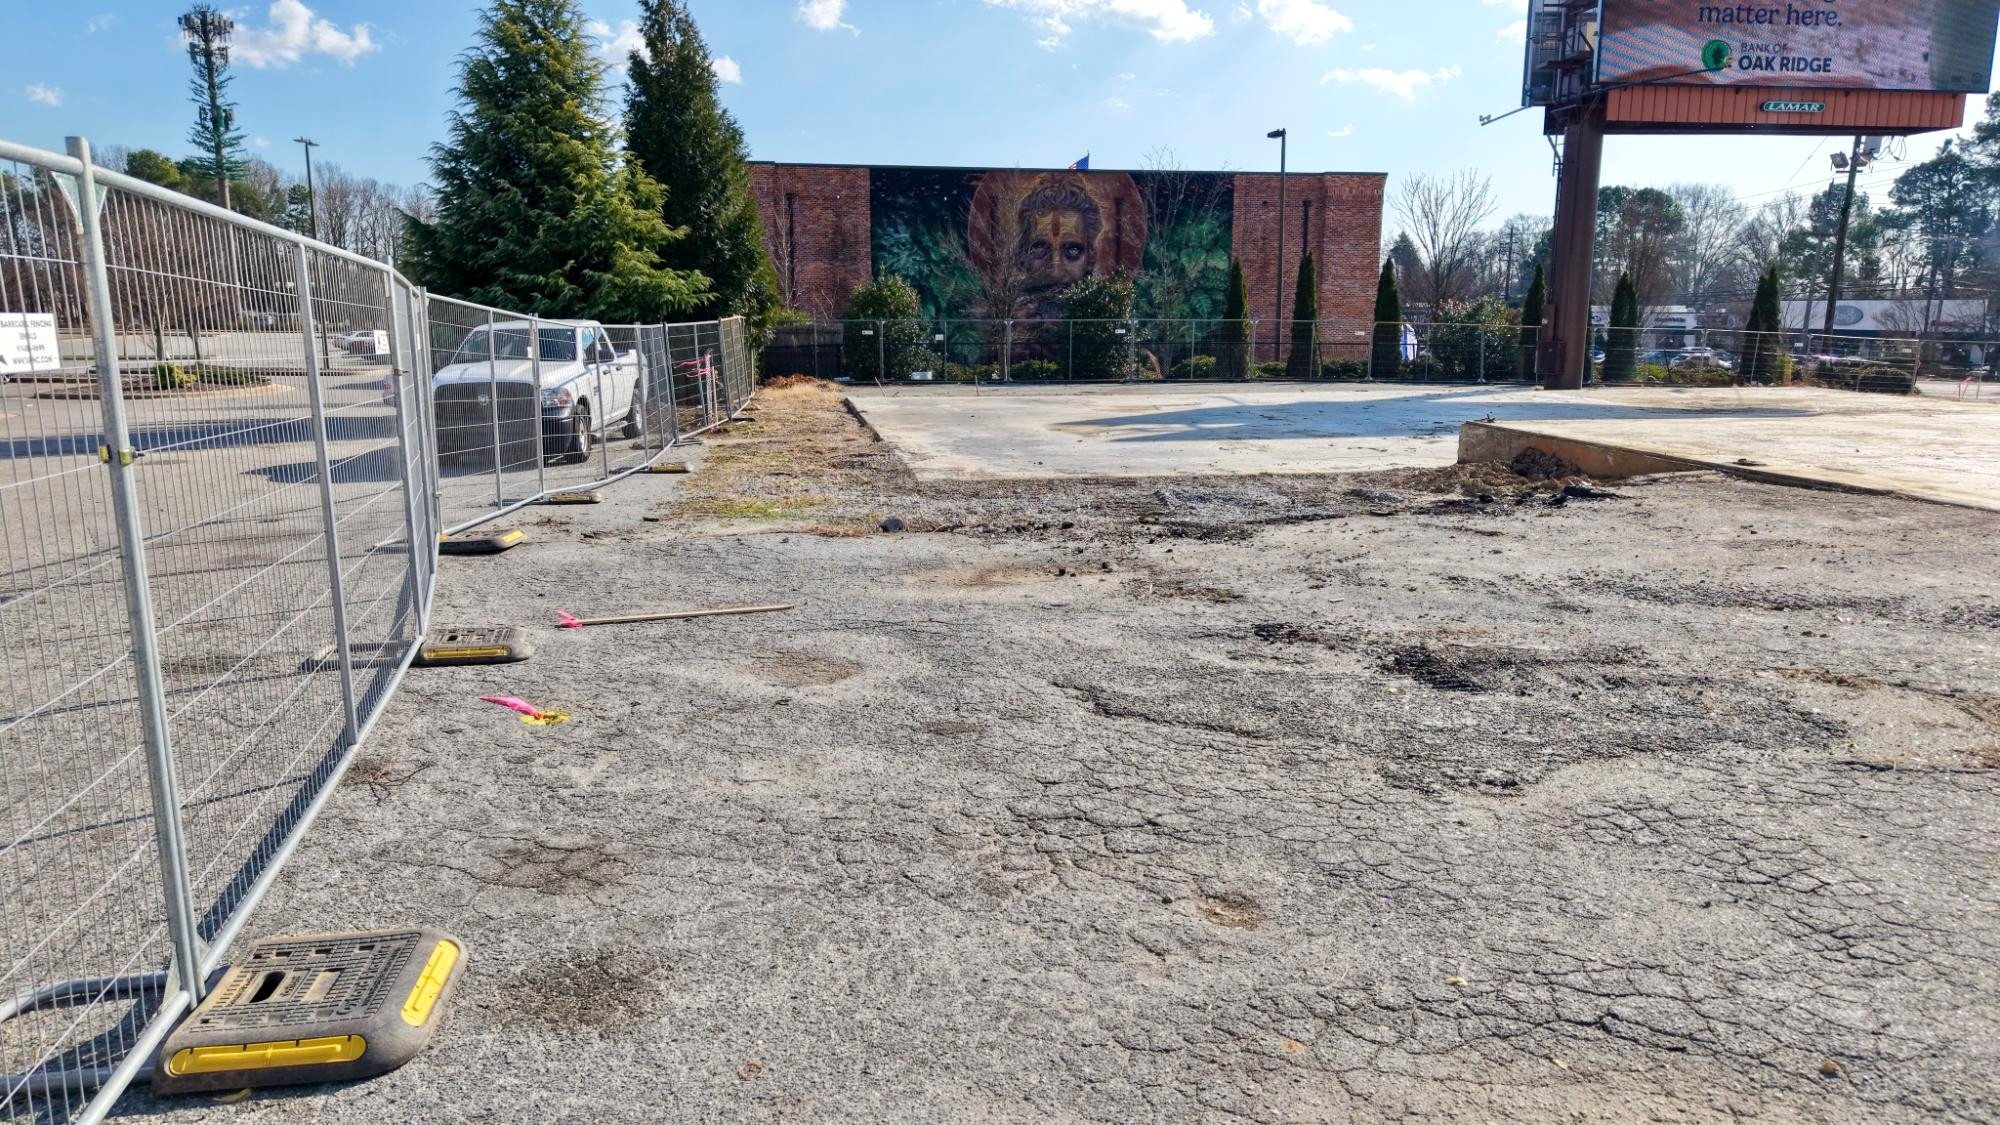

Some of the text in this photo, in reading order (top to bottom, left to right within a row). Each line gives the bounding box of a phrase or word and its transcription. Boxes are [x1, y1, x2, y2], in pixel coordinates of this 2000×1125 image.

[1698, 3, 1842, 27] matter here.
[1741, 42, 1789, 54] BANK OF
[1738, 55, 1832, 73] OAK RIDGE
[1768, 103, 1820, 111] LAMAR
